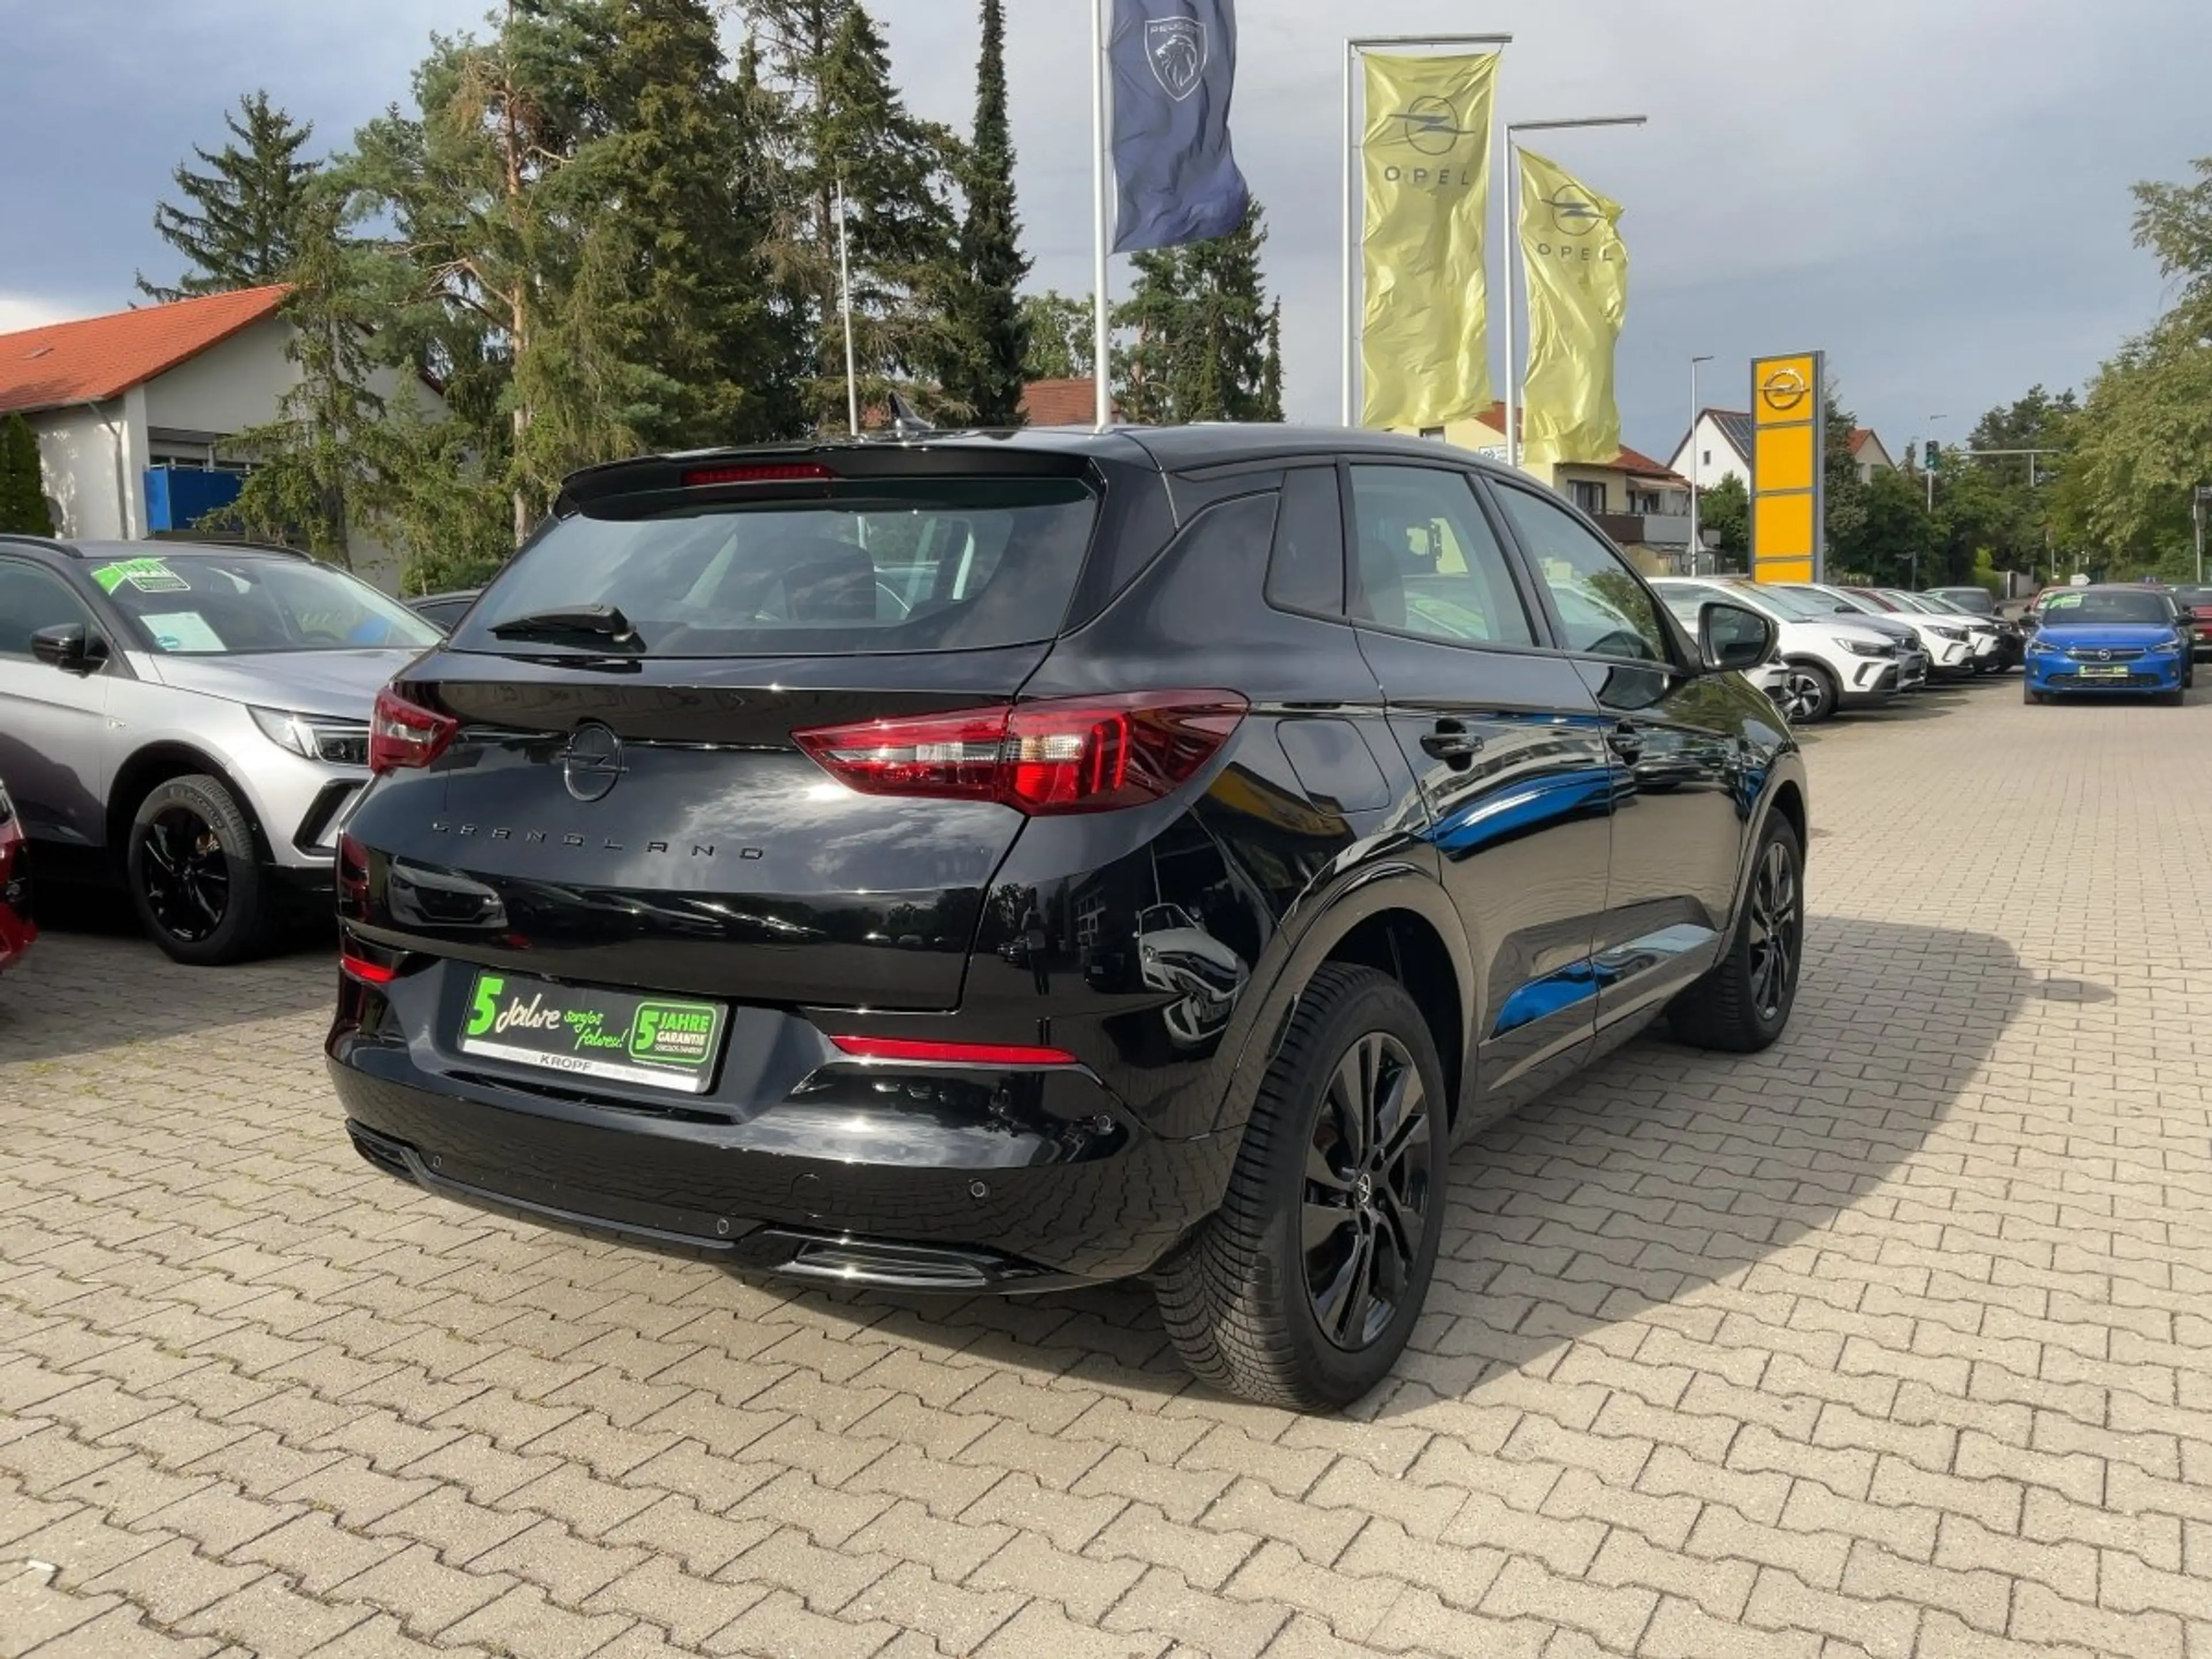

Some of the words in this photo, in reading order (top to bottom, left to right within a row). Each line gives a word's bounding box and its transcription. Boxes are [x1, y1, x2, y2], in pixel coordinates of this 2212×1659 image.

[1384, 165, 1470, 185] OPEL
[1537, 243, 1614, 262] OPEL
[468, 977, 504, 1035] 5
[635, 1010, 659, 1050] 5
[658, 1012, 710, 1032] JAHRE
[539, 1054, 592, 1071] KROPF
